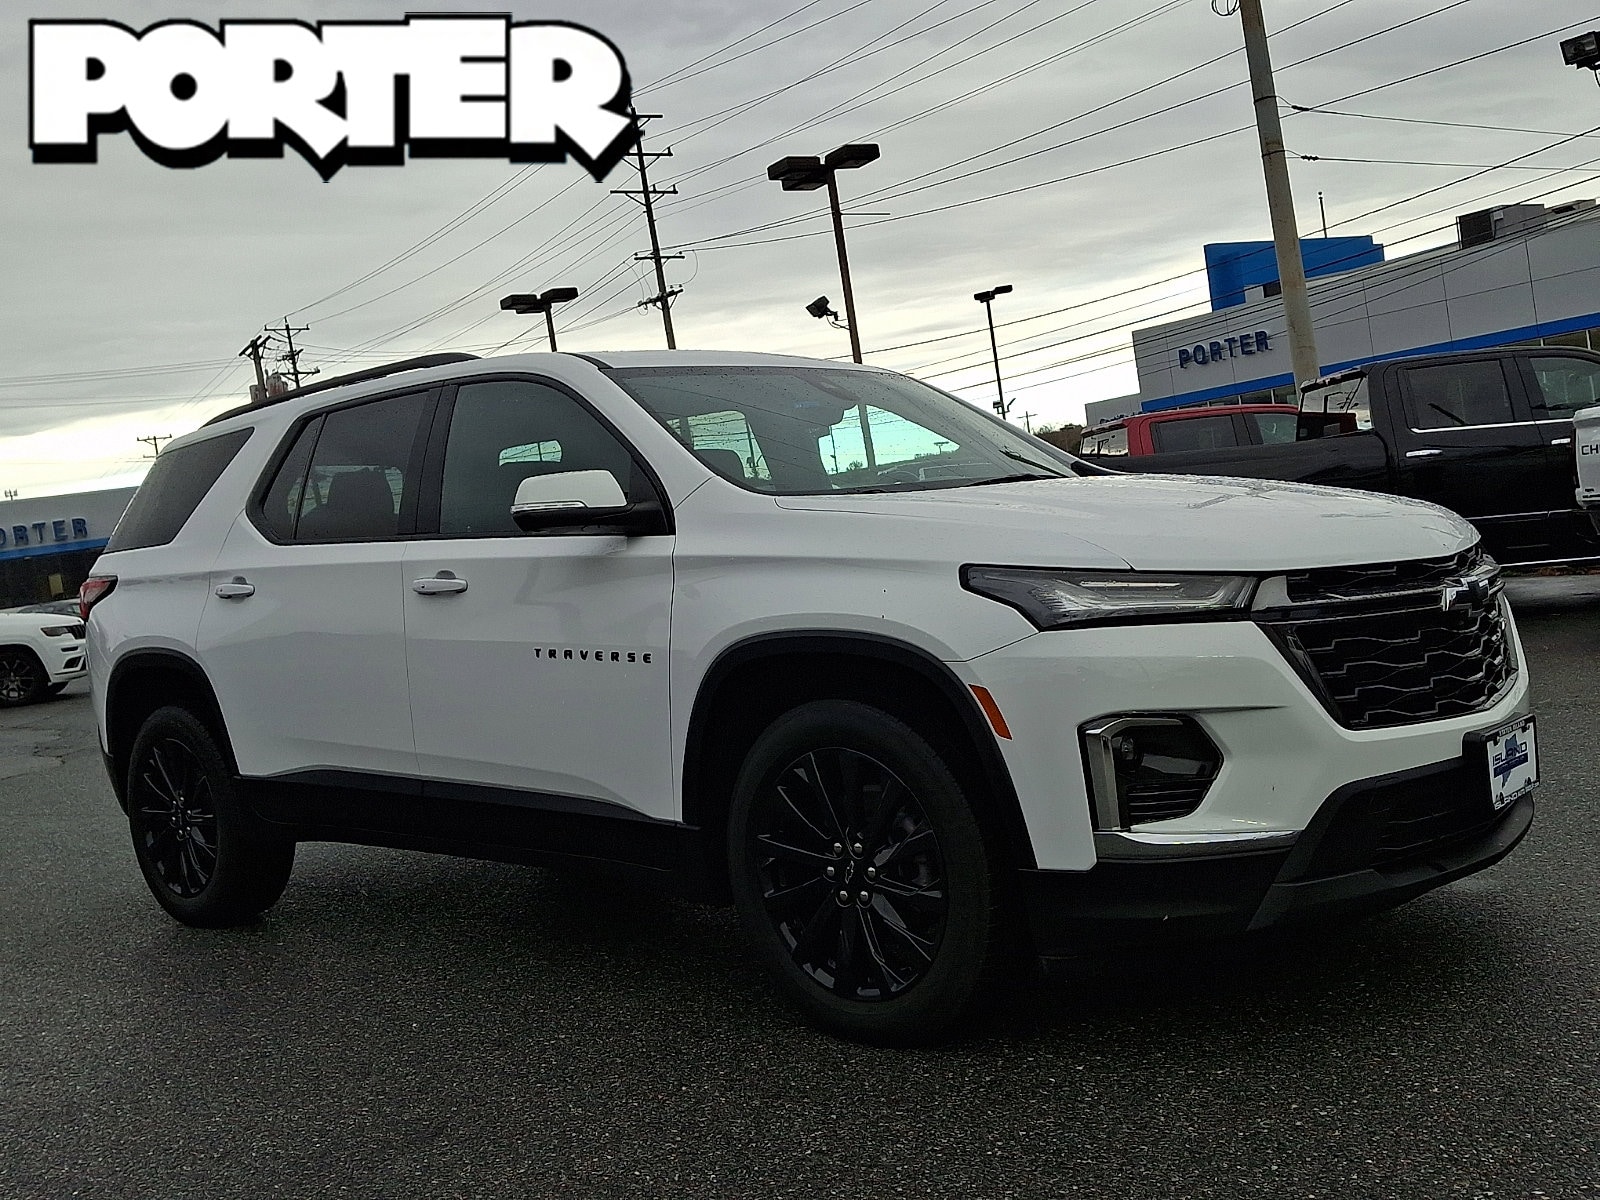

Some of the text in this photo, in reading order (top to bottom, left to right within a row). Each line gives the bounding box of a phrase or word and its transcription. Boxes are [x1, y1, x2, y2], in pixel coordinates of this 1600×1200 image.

[1178, 330, 1272, 369] PORTER
[534, 648, 652, 664] TRAVERSE
[1493, 741, 1528, 766] ISLAND
